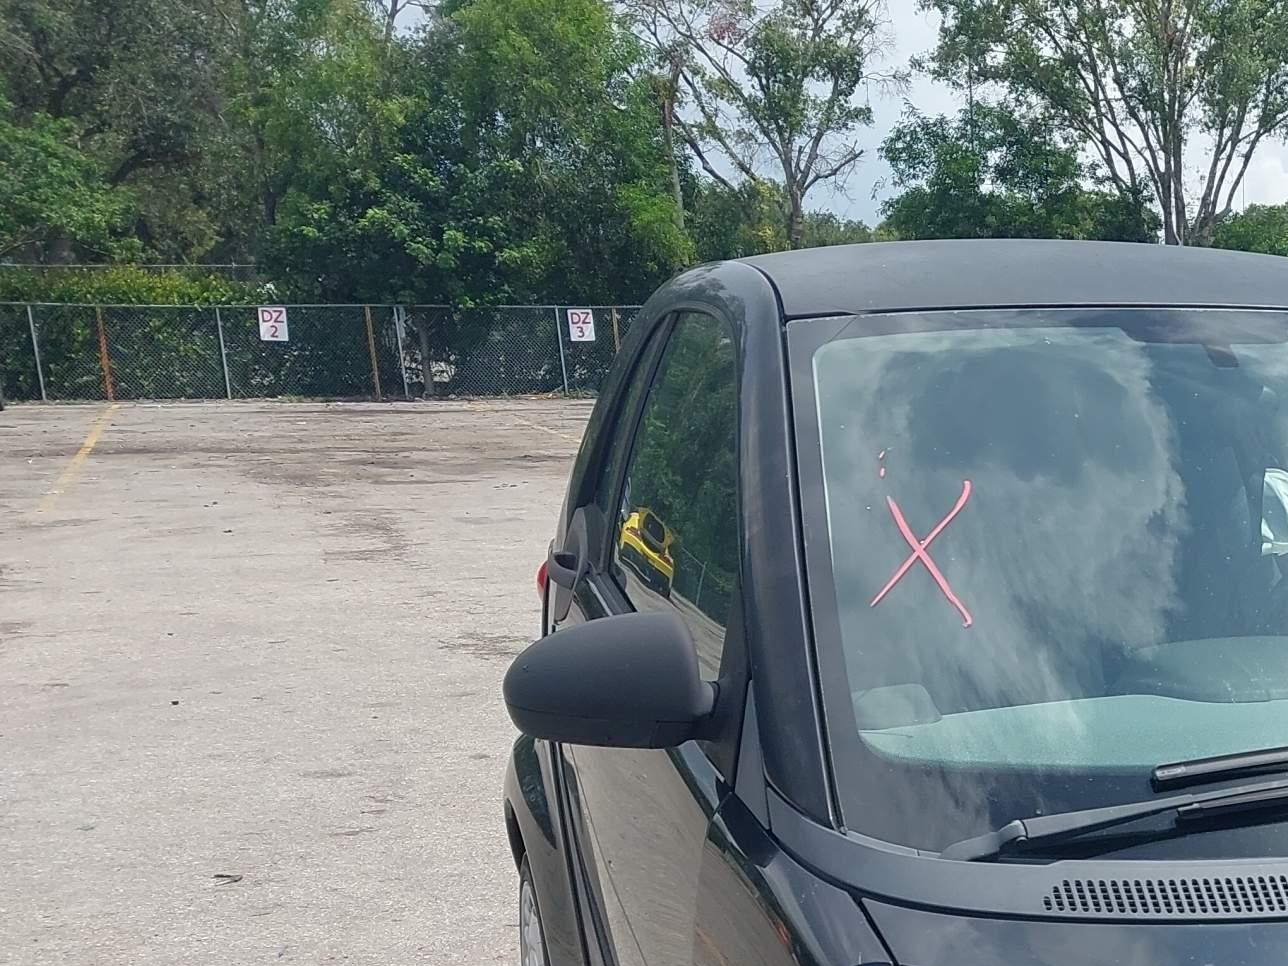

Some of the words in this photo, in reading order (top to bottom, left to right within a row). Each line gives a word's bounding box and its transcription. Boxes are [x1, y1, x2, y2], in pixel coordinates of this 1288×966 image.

[261, 310, 284, 323] DZ
[570, 311, 591, 325] DZ
[270, 325, 278, 338] 2
[577, 326, 585, 338] 3
